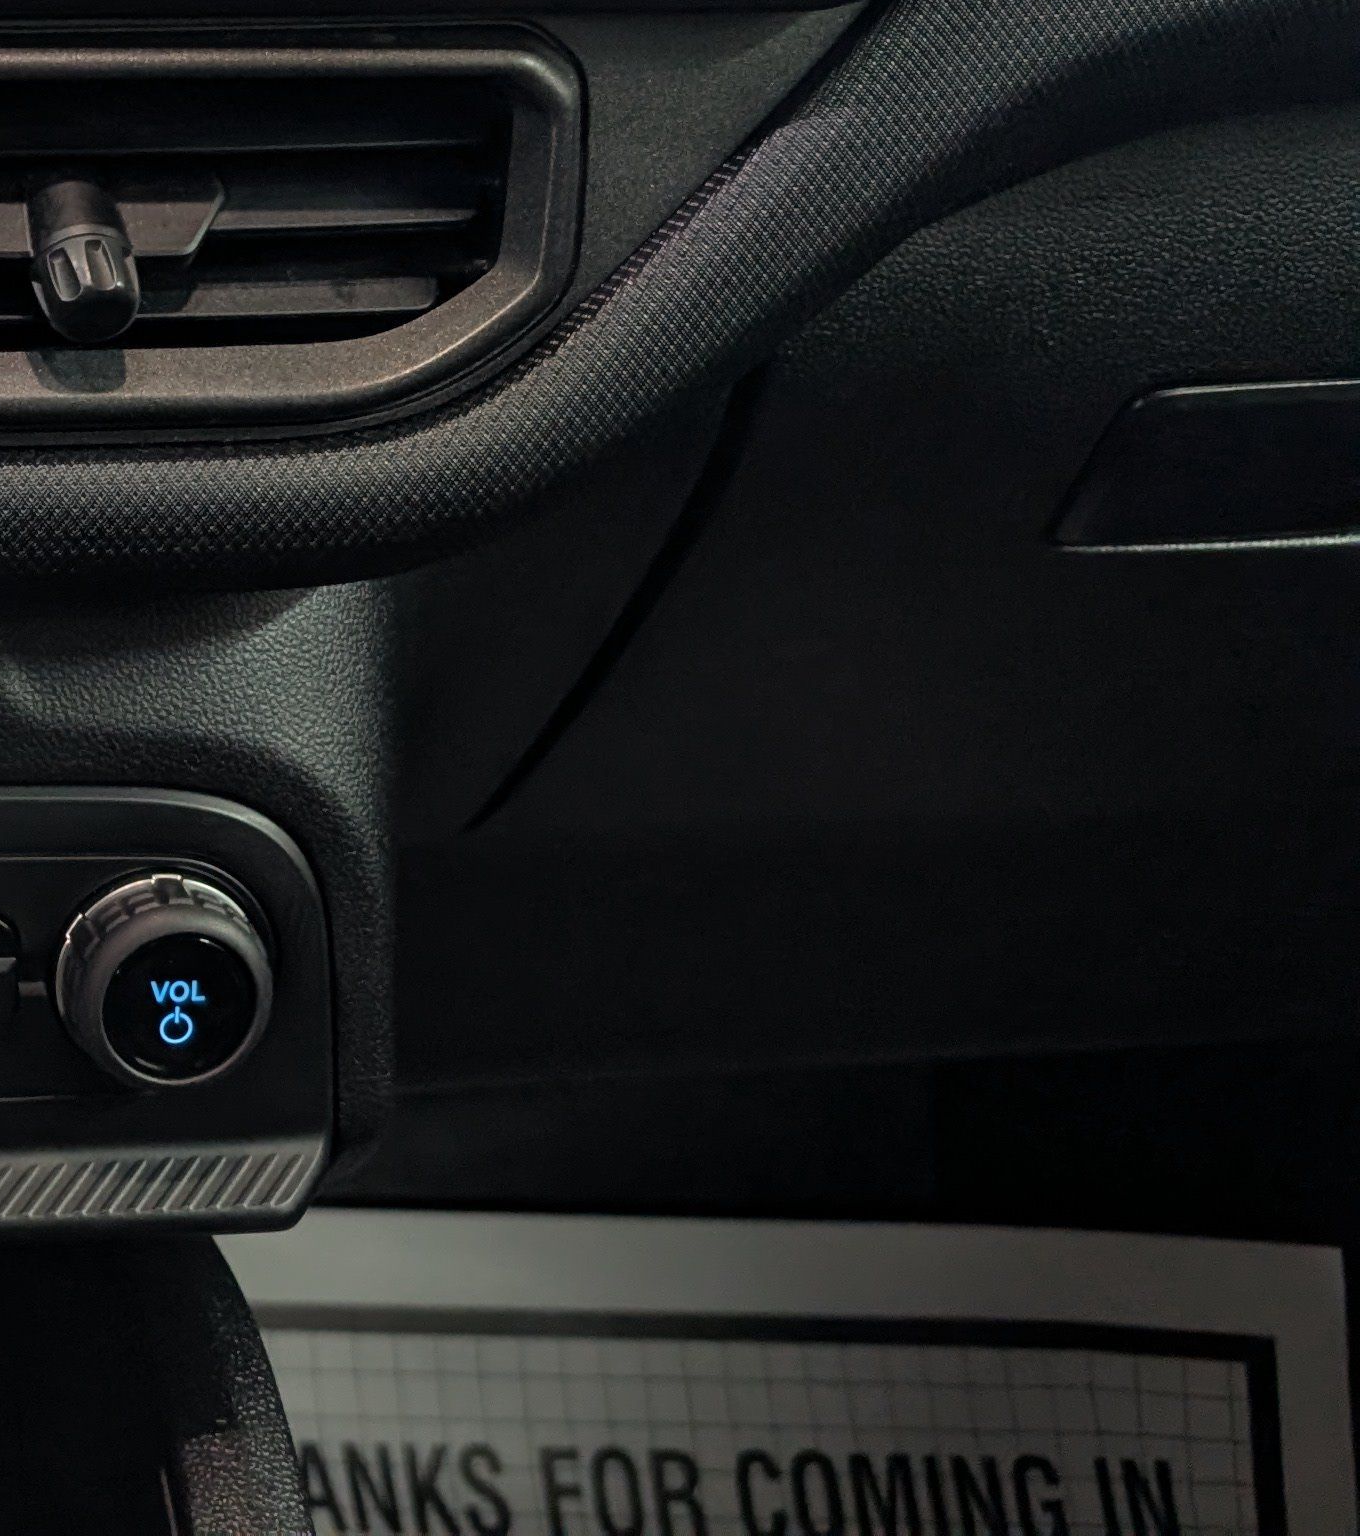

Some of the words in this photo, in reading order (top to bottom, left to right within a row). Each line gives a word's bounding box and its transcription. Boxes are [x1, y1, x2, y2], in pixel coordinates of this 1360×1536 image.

[149, 979, 208, 1005] VOL
[298, 1439, 510, 1536] ANKS
[538, 1444, 708, 1536] FOR
[740, 1447, 1070, 1536] COMING
[1092, 1454, 1180, 1536] IN
